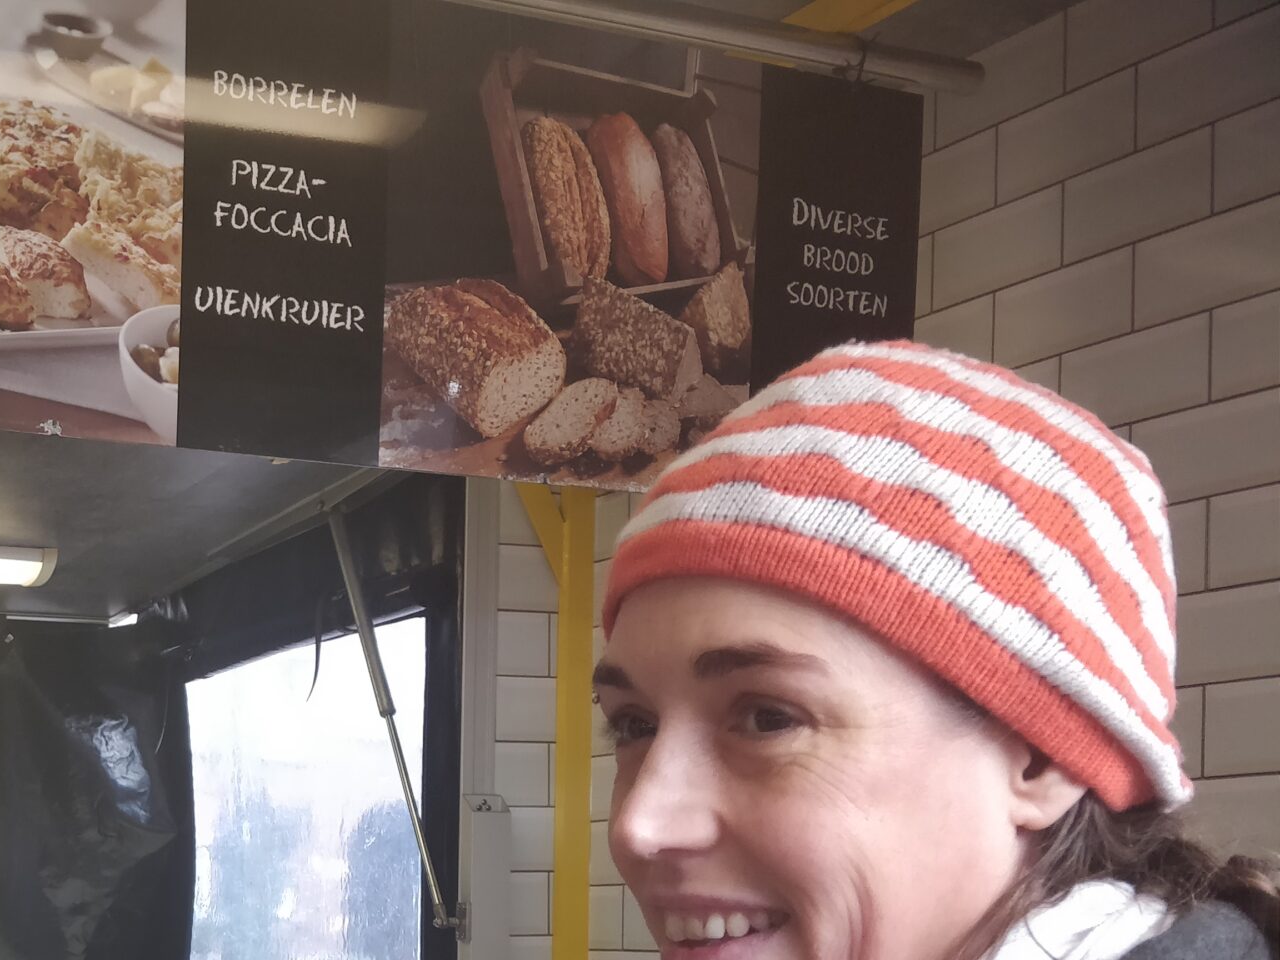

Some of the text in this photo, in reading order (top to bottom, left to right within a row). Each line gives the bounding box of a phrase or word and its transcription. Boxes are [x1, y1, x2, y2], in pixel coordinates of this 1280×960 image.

[213, 70, 357, 118] BORRELEN
[231, 159, 327, 199] PIZZA-
[214, 201, 352, 247] FOCCACIA
[792, 197, 889, 240] DIVERSE
[803, 244, 874, 275] BROOD
[194, 286, 365, 332] UIENKRUIER
[787, 281, 888, 317] SOORTEN
